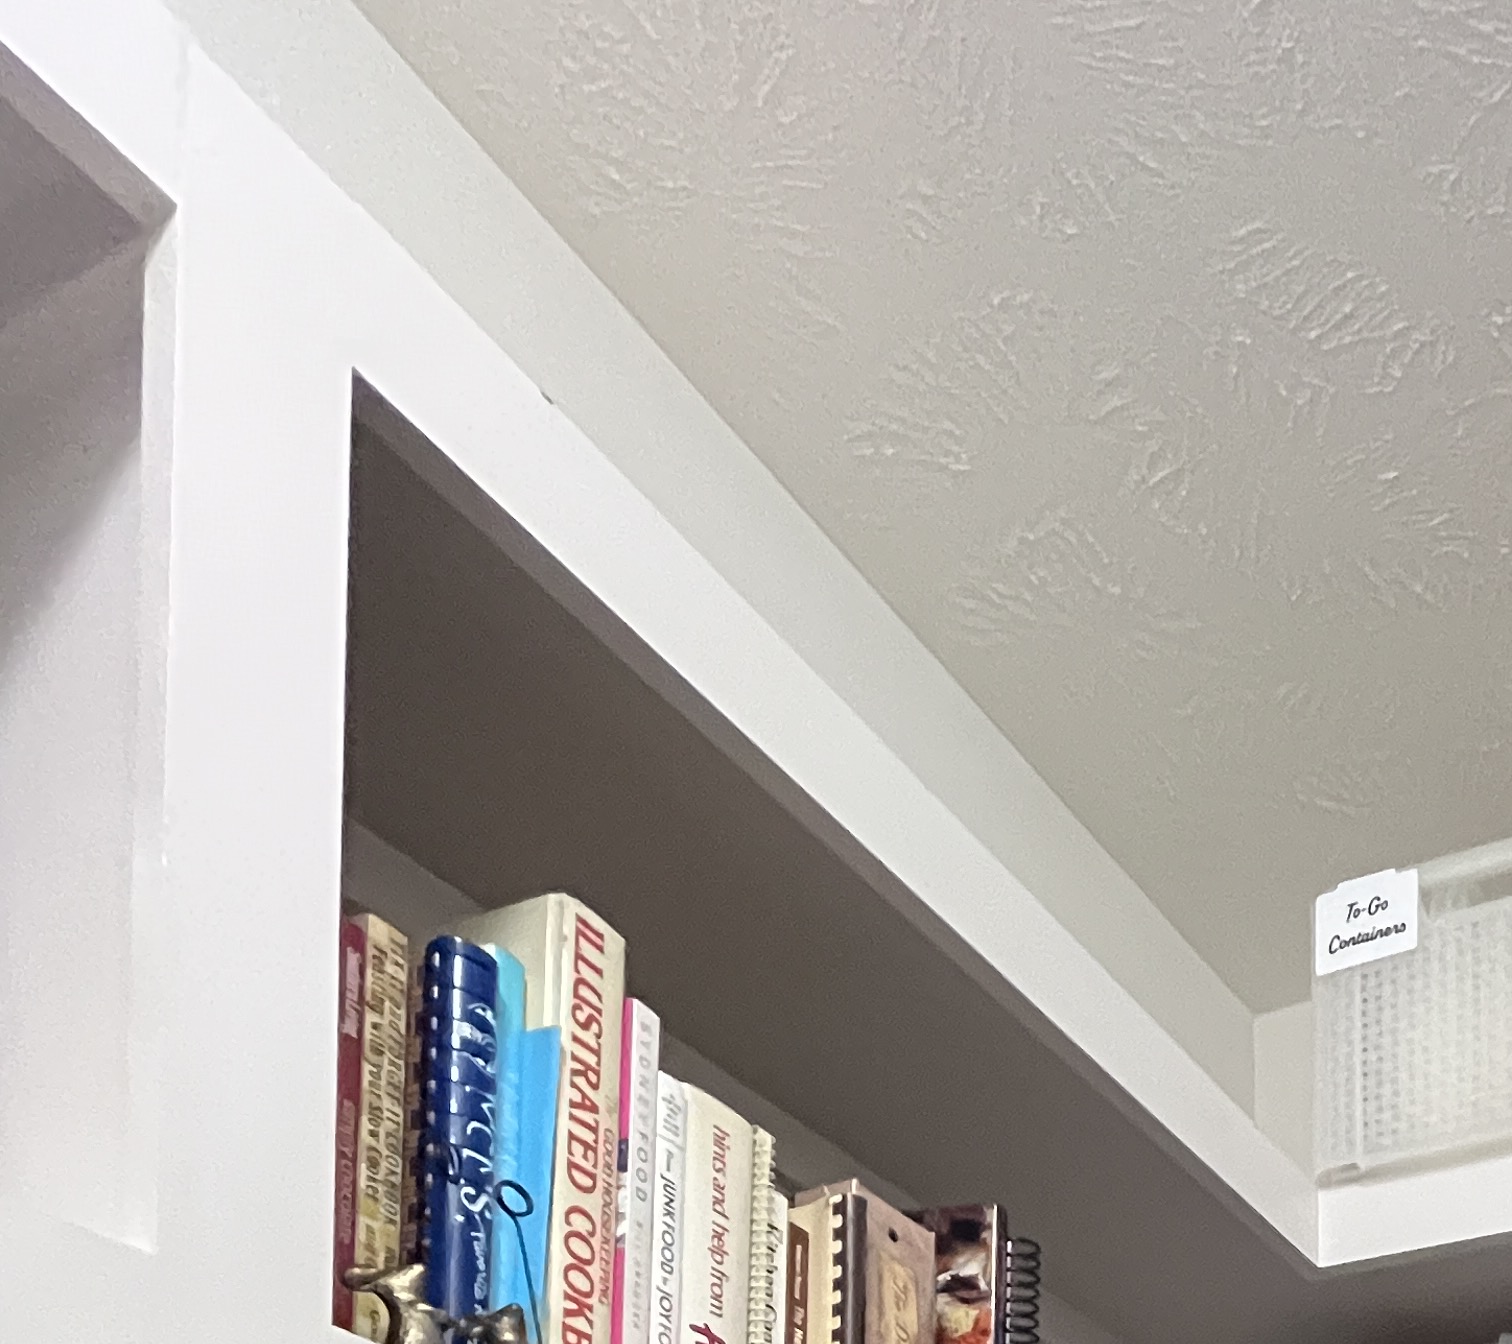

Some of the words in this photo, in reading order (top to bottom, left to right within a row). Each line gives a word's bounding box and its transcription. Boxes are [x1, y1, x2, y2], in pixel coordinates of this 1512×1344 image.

[1345, 895, 1389, 923] To-Go
[1328, 922, 1407, 955] Containers
[565, 911, 606, 1195] ILLUSTRATED
[711, 1124, 731, 1177] hints
[711, 1177, 730, 1221] and
[706, 1220, 730, 1266] help
[708, 1265, 730, 1319] from
